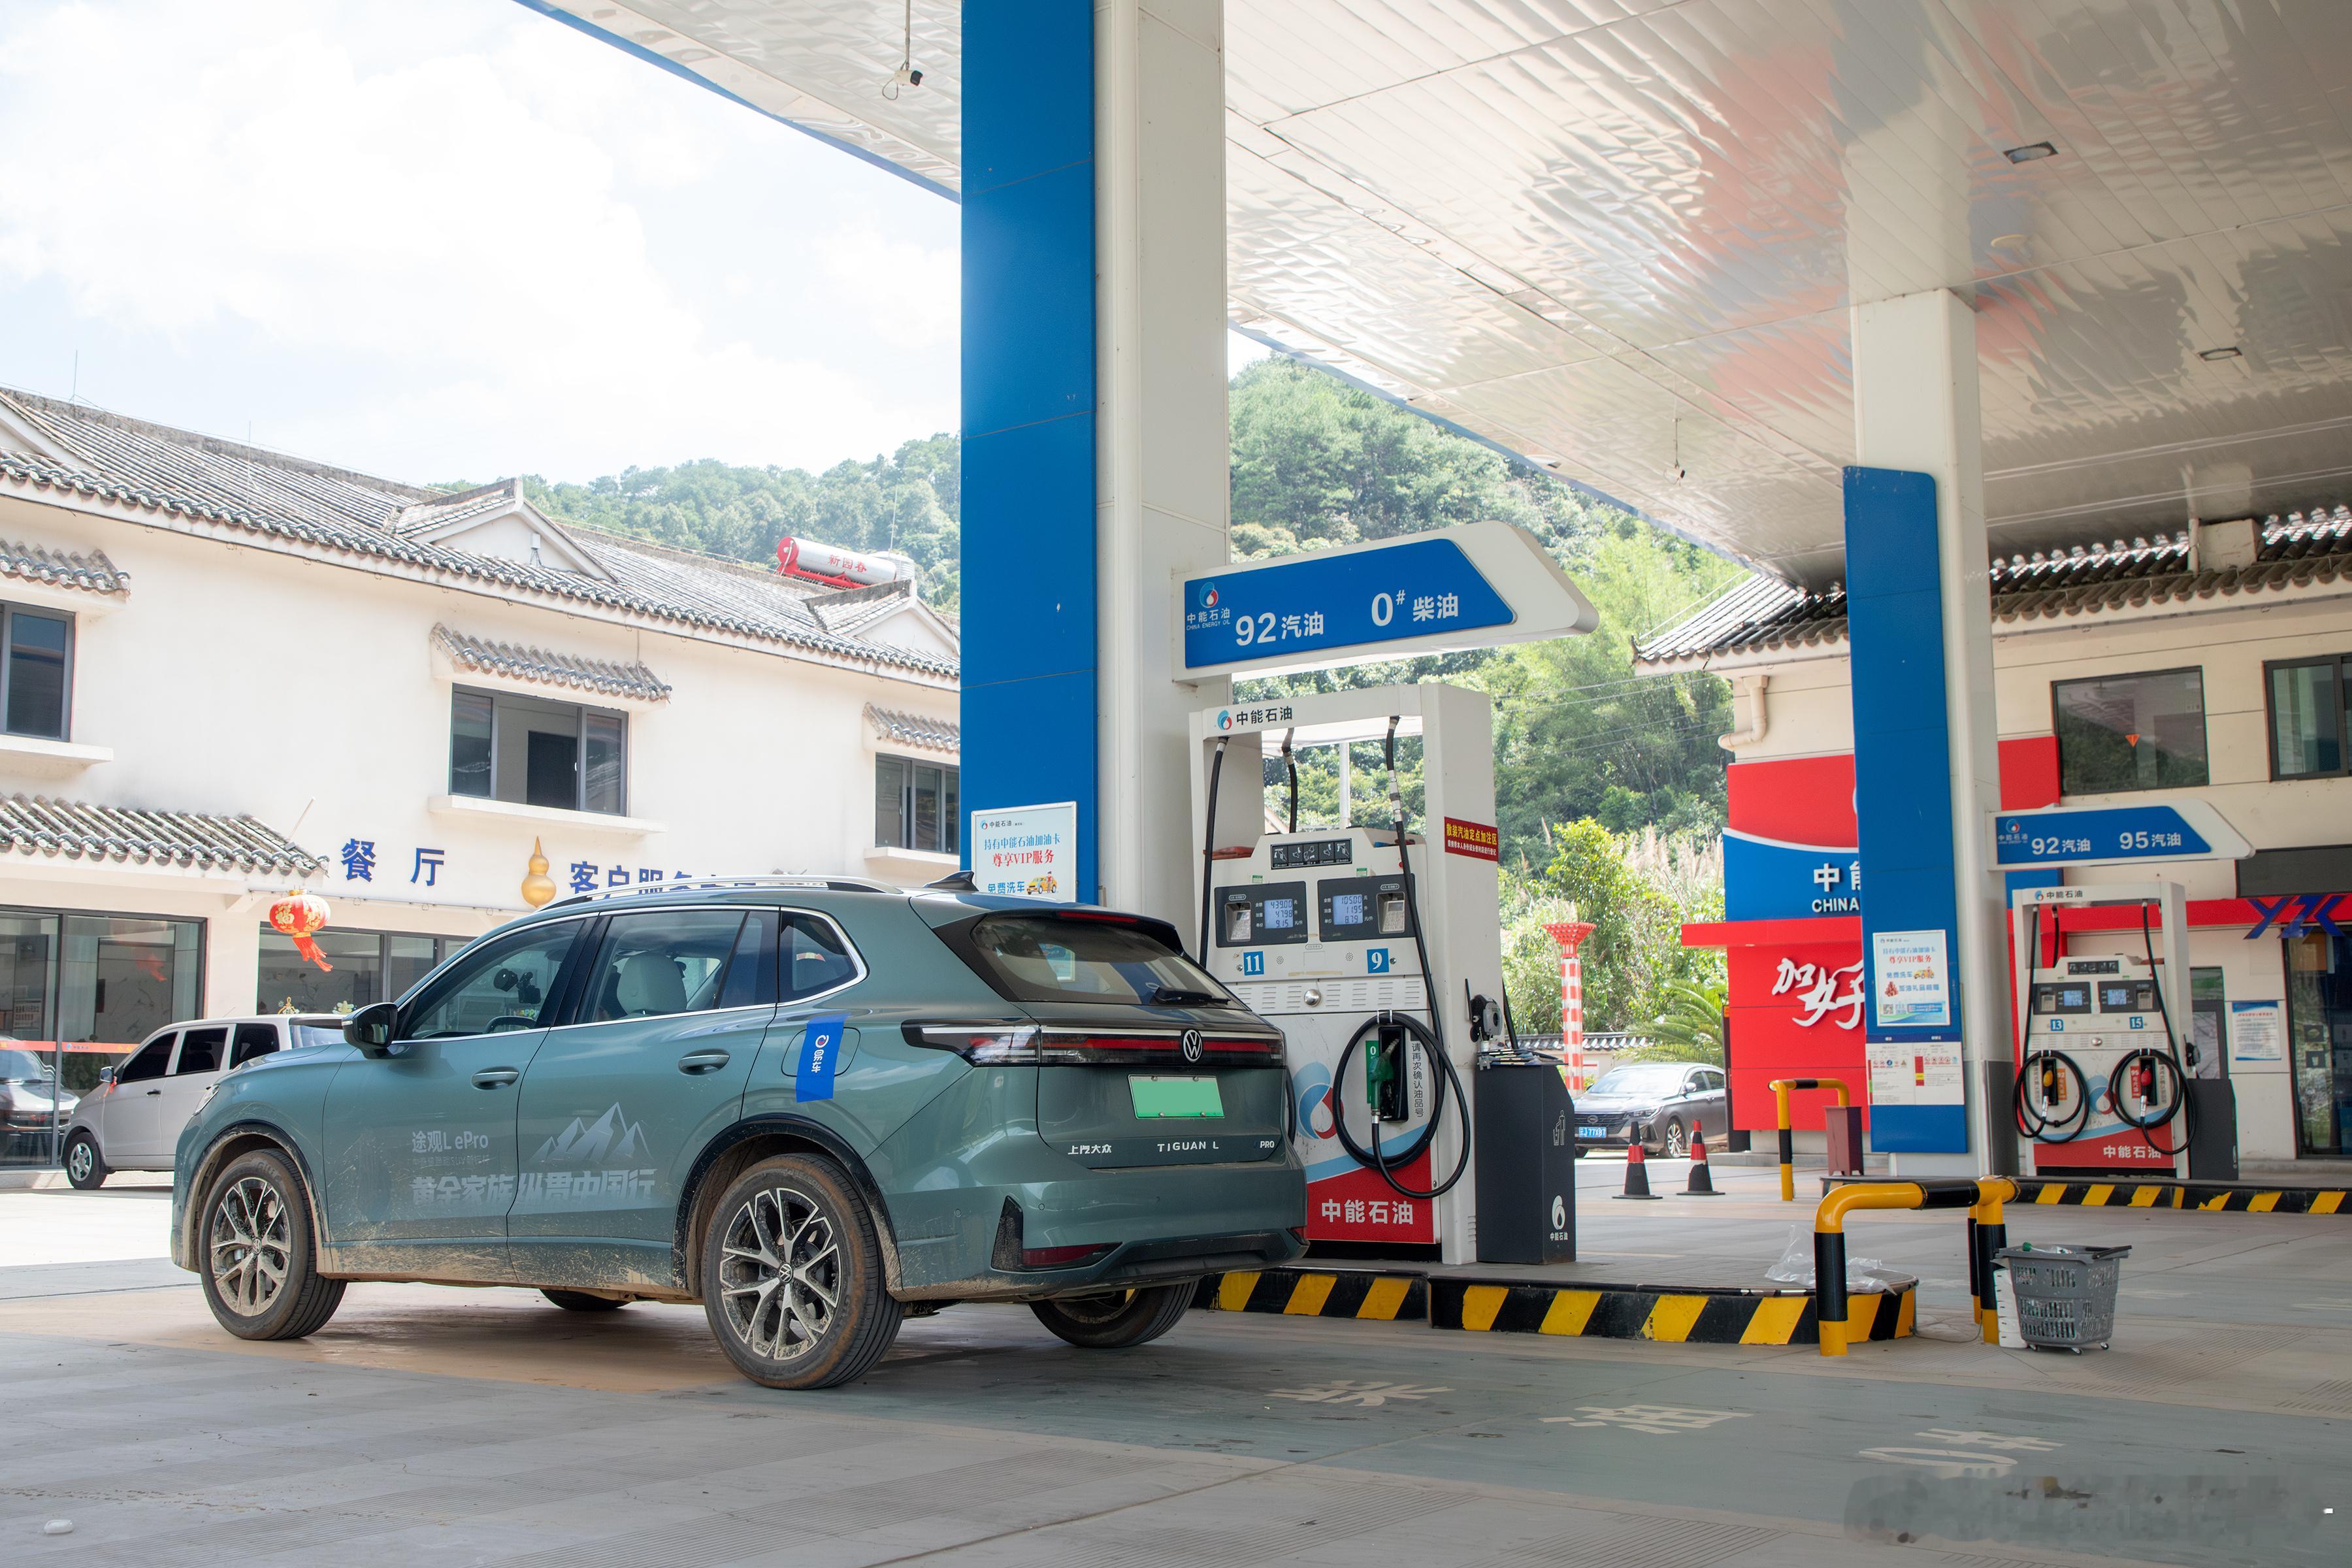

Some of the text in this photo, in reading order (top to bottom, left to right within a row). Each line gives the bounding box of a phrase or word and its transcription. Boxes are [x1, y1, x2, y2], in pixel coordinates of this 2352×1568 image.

[1186, 607, 1231, 625] 中能石油
[1235, 612, 1276, 646] 92
[1281, 613, 1324, 640] 汽油
[1413, 592, 1458, 621] 柴油
[1236, 706, 1293, 725] 中能石油
[985, 833, 1060, 851] 持有中能石油加油卡
[1446, 823, 1497, 845] 散装汽油定点加注区
[2031, 831, 2181, 855] 92 汽油 95 汽油
[341, 838, 445, 886] 餐厅
[993, 849, 1054, 868] 尊享VIP服务
[1812, 897, 1859, 913] CHINA
[1245, 955, 1261, 972] 11
[1371, 951, 1382, 970] 9
[2052, 1021, 2063, 1031] 13
[2131, 1017, 2142, 1028] 15
[1412, 1043, 1424, 1117] 请再次确认油品号
[455, 1131, 489, 1149] ePro
[1068, 1144, 1112, 1155] 上汽大众
[1158, 1141, 1206, 1152] TIGUAN
[1213, 1141, 1219, 1150] L
[2103, 1145, 2161, 1159] 中能石油
[1322, 1198, 1413, 1224] 中能石油
